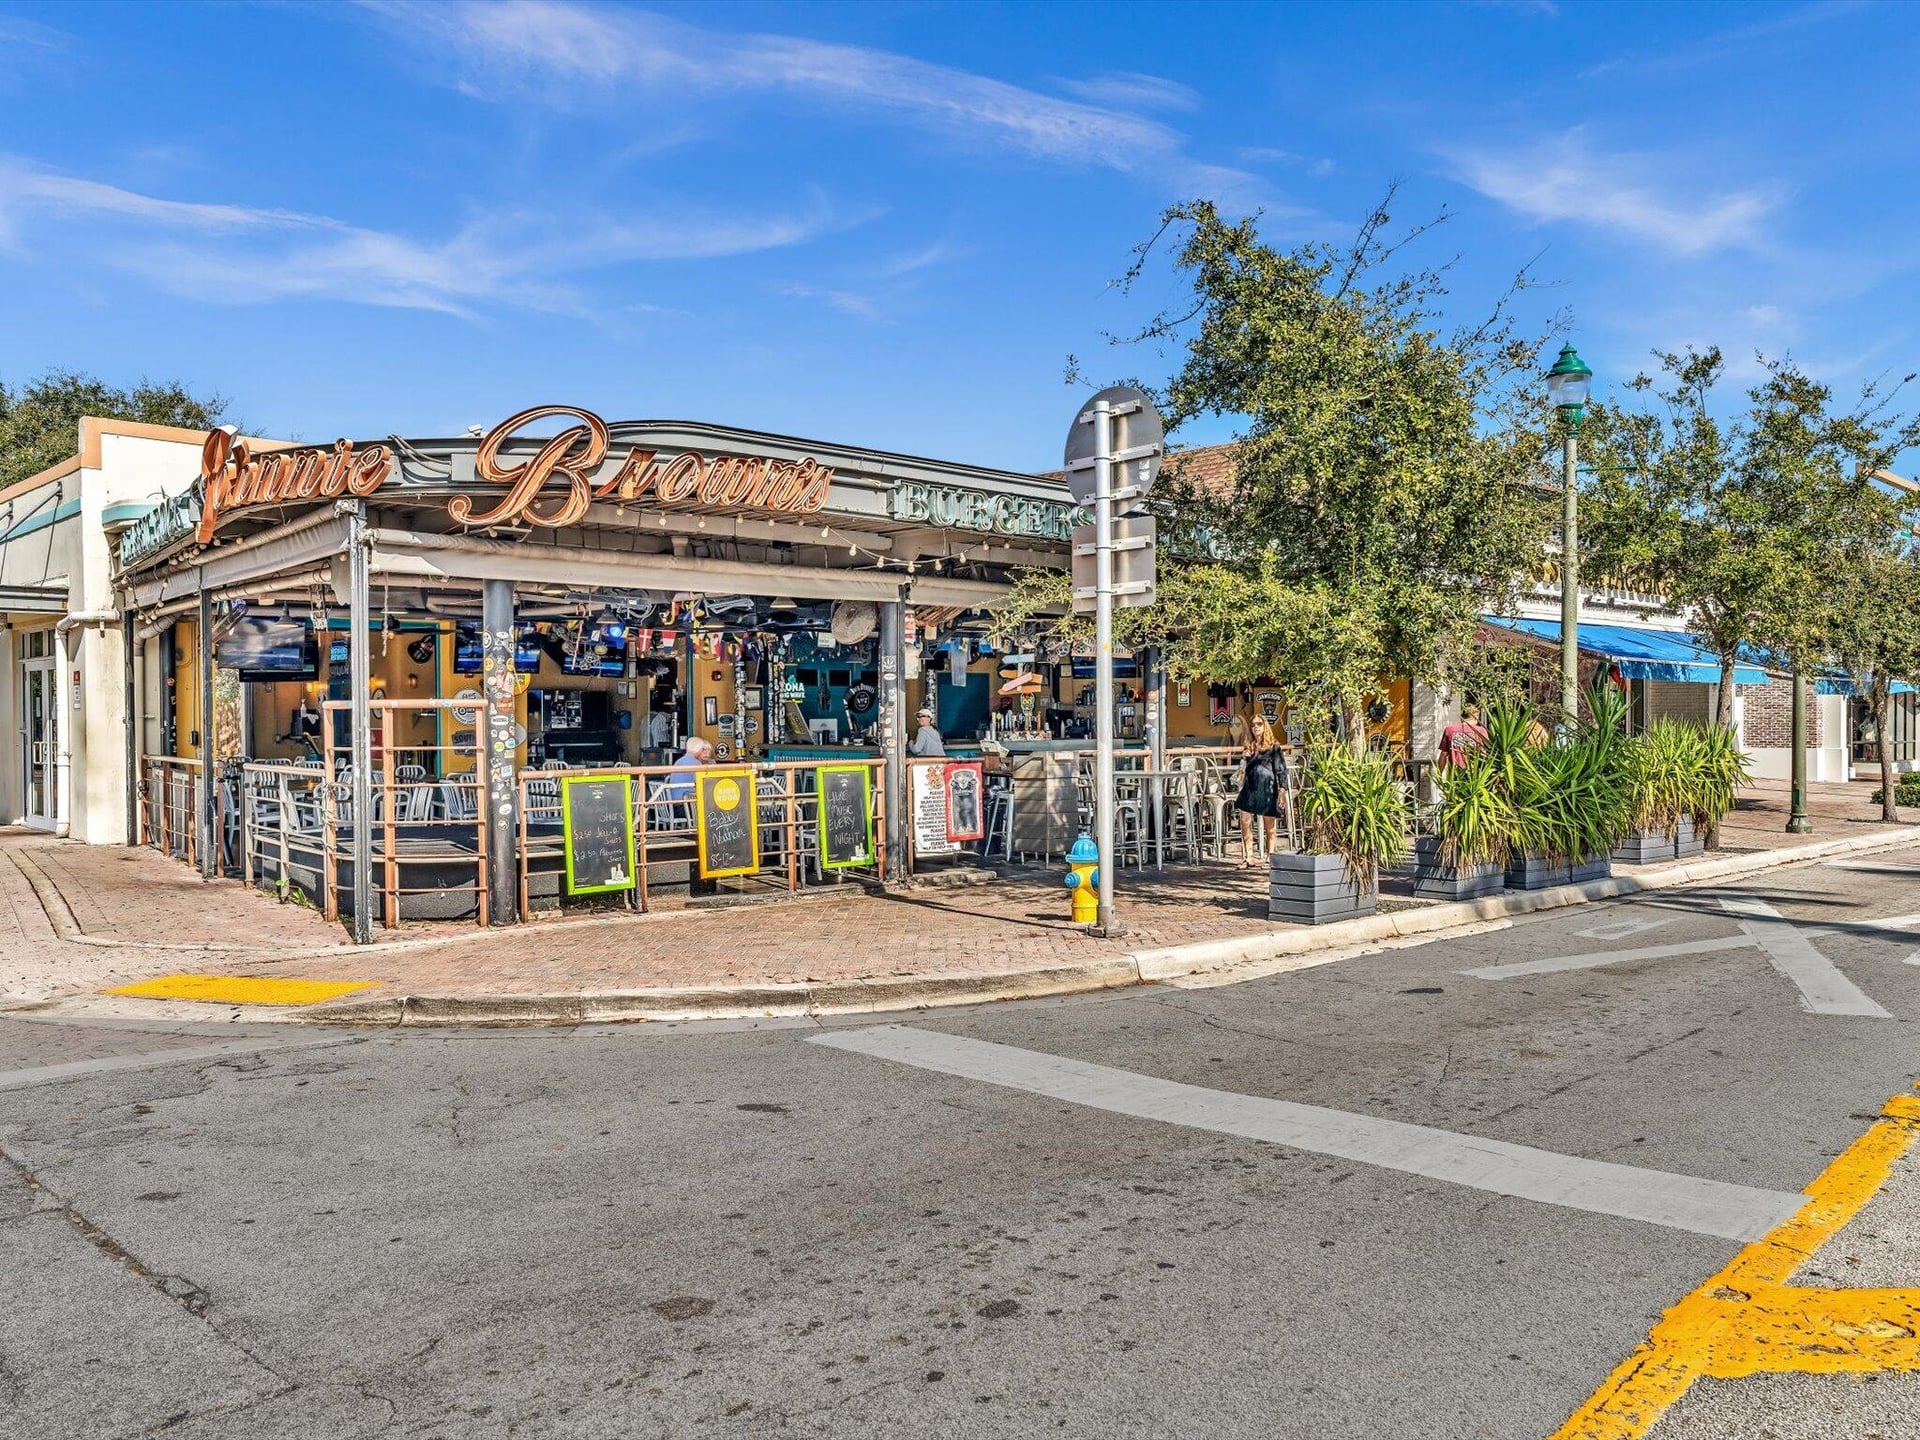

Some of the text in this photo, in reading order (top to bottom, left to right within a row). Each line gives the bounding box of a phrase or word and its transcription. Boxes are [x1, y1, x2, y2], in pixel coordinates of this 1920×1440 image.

[448, 405, 835, 527] Brown's
[784, 682, 805, 692] ONA
[454, 734, 475, 744] SOUT
[826, 789, 848, 804] LIVE
[829, 816, 856, 832] EVERY
[834, 832, 860, 847] NIGHT
